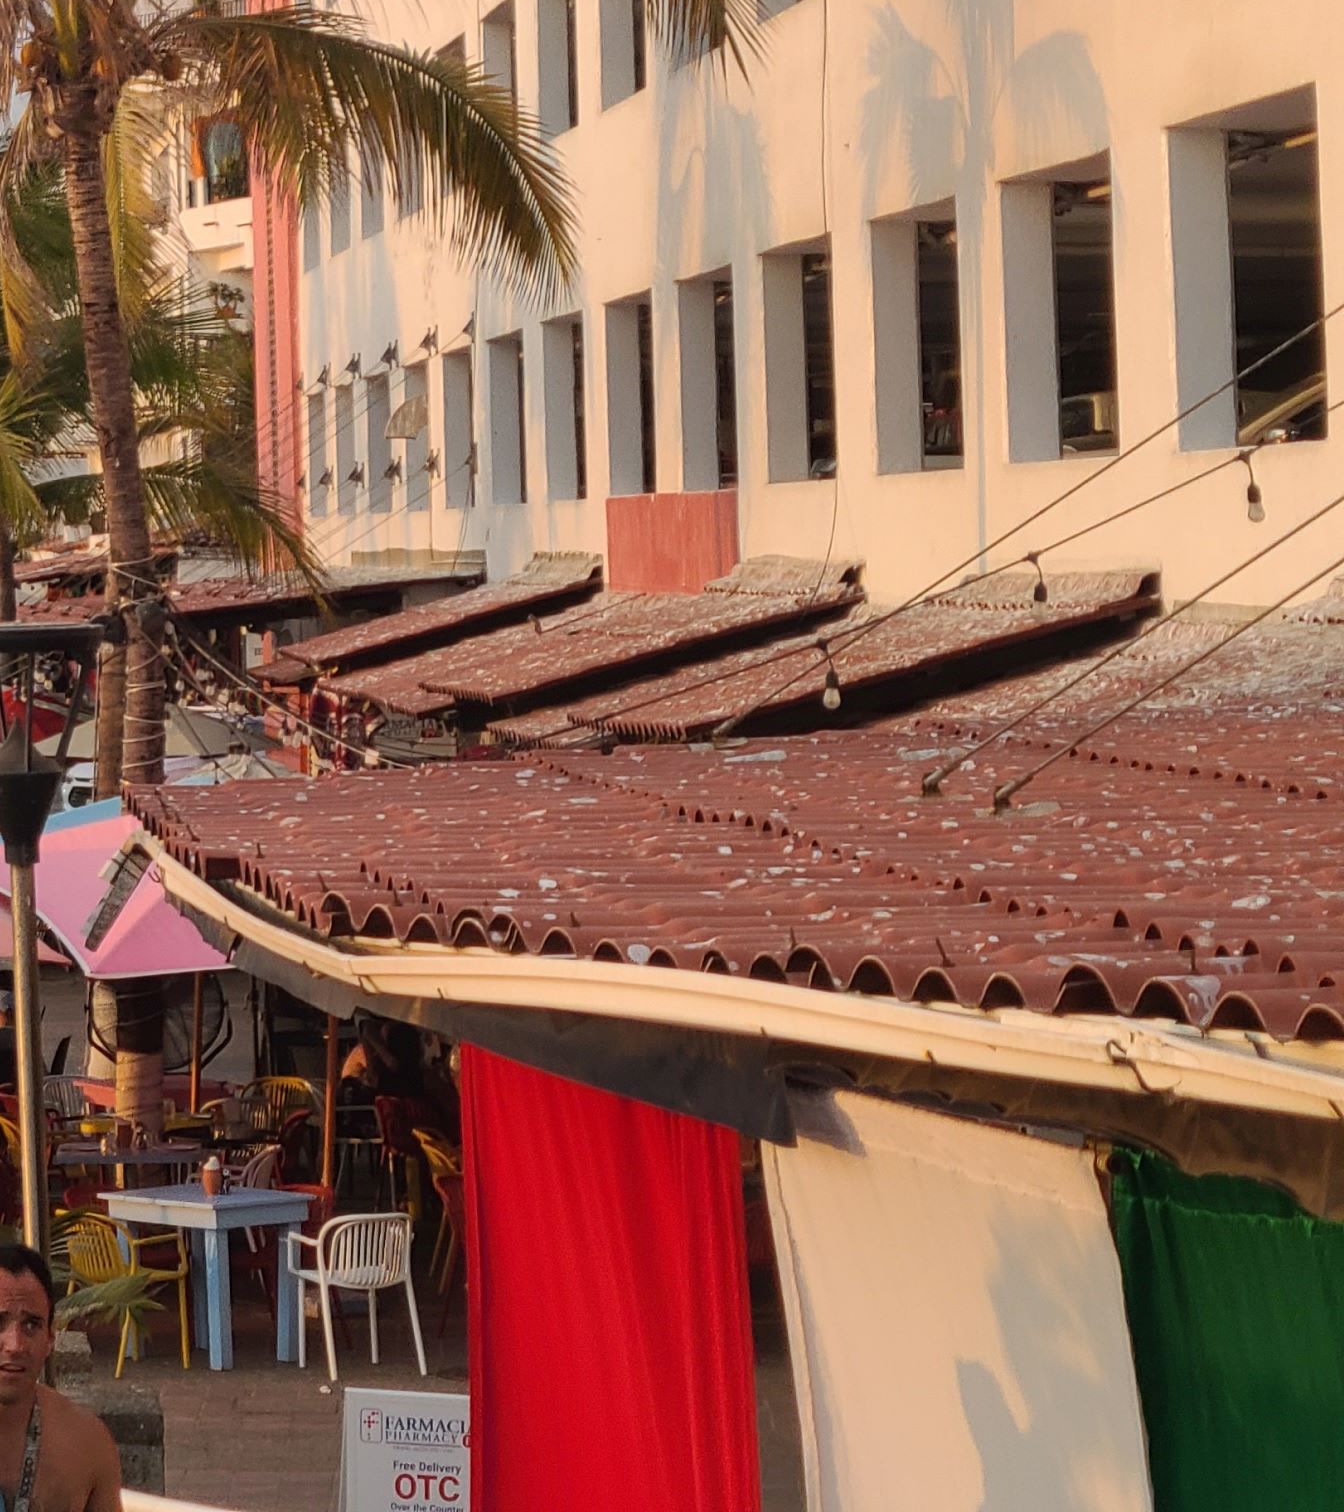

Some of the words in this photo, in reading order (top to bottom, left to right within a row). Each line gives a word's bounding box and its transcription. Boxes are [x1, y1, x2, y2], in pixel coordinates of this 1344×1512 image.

[385, 1416, 471, 1434] FARMACI
[385, 1430, 459, 1444] PHARMACY
[393, 1460, 416, 1471] Free
[419, 1462, 462, 1476] Delivery
[394, 1473, 461, 1502] OTC
[390, 1502, 410, 1512] Over
[413, 1503, 428, 1512] the
